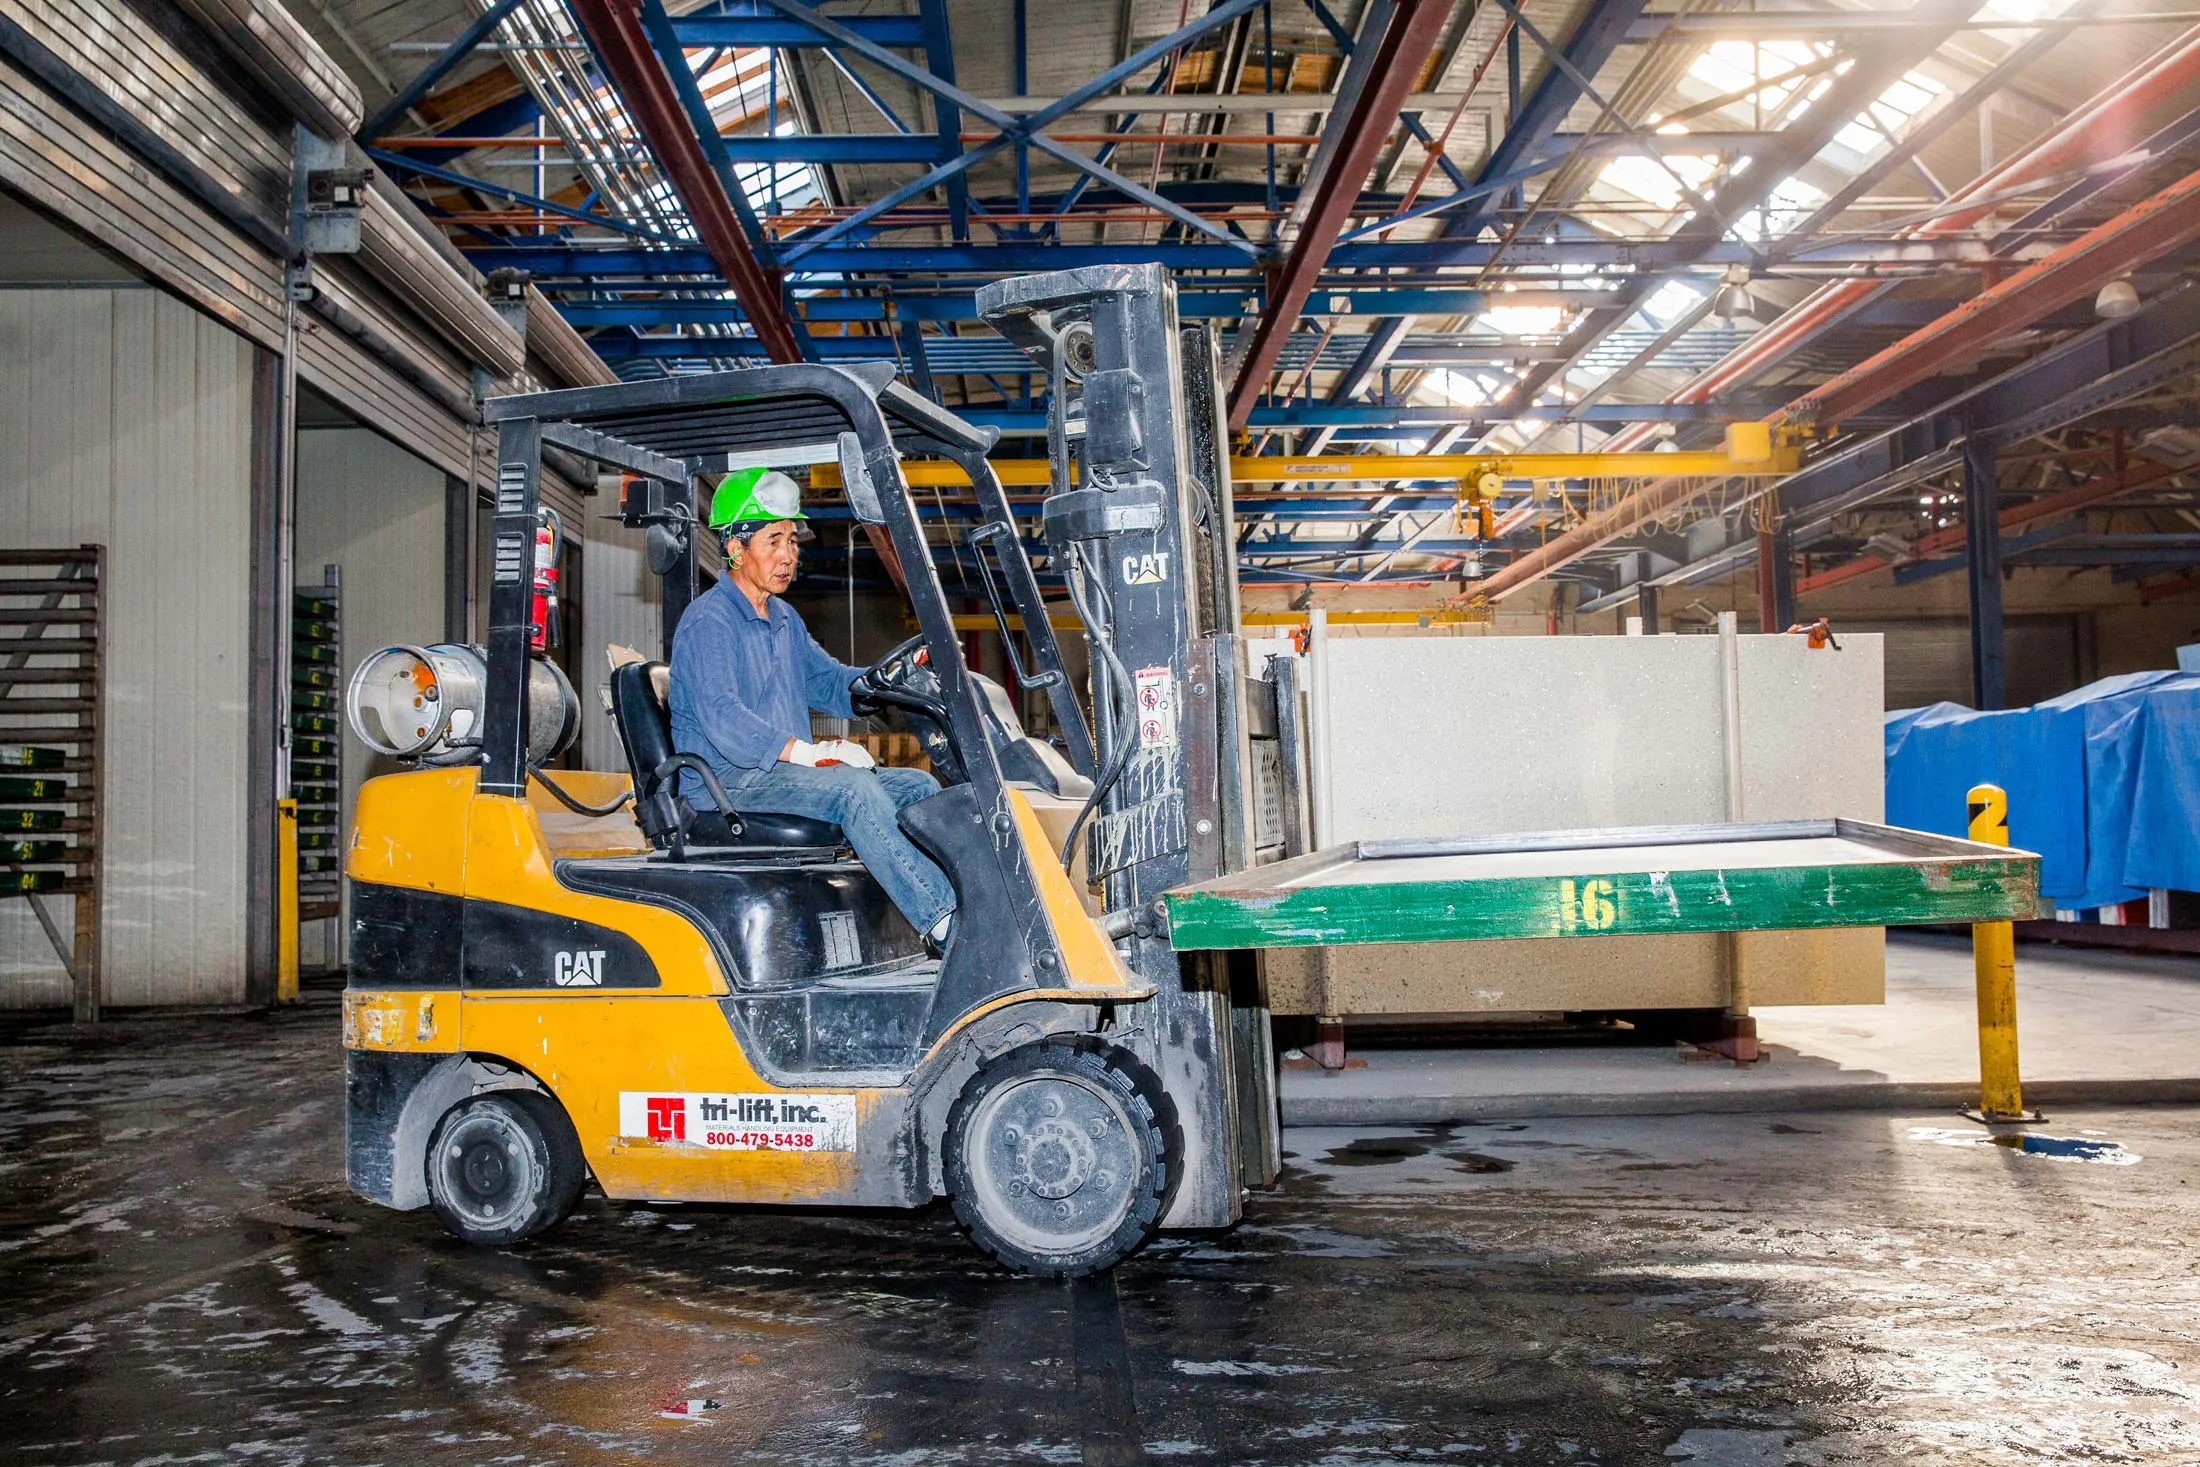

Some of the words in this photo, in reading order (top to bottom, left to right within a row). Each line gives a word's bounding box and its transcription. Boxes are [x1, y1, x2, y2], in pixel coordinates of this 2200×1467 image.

[1123, 552, 1169, 585] CAT
[1556, 879, 1616, 930] 16
[555, 950, 606, 986] CAT
[705, 1124, 740, 1132] MATERIALS
[776, 1125, 813, 1133] EQUIPMENT
[706, 1131, 814, 1147] 800-479-5438
